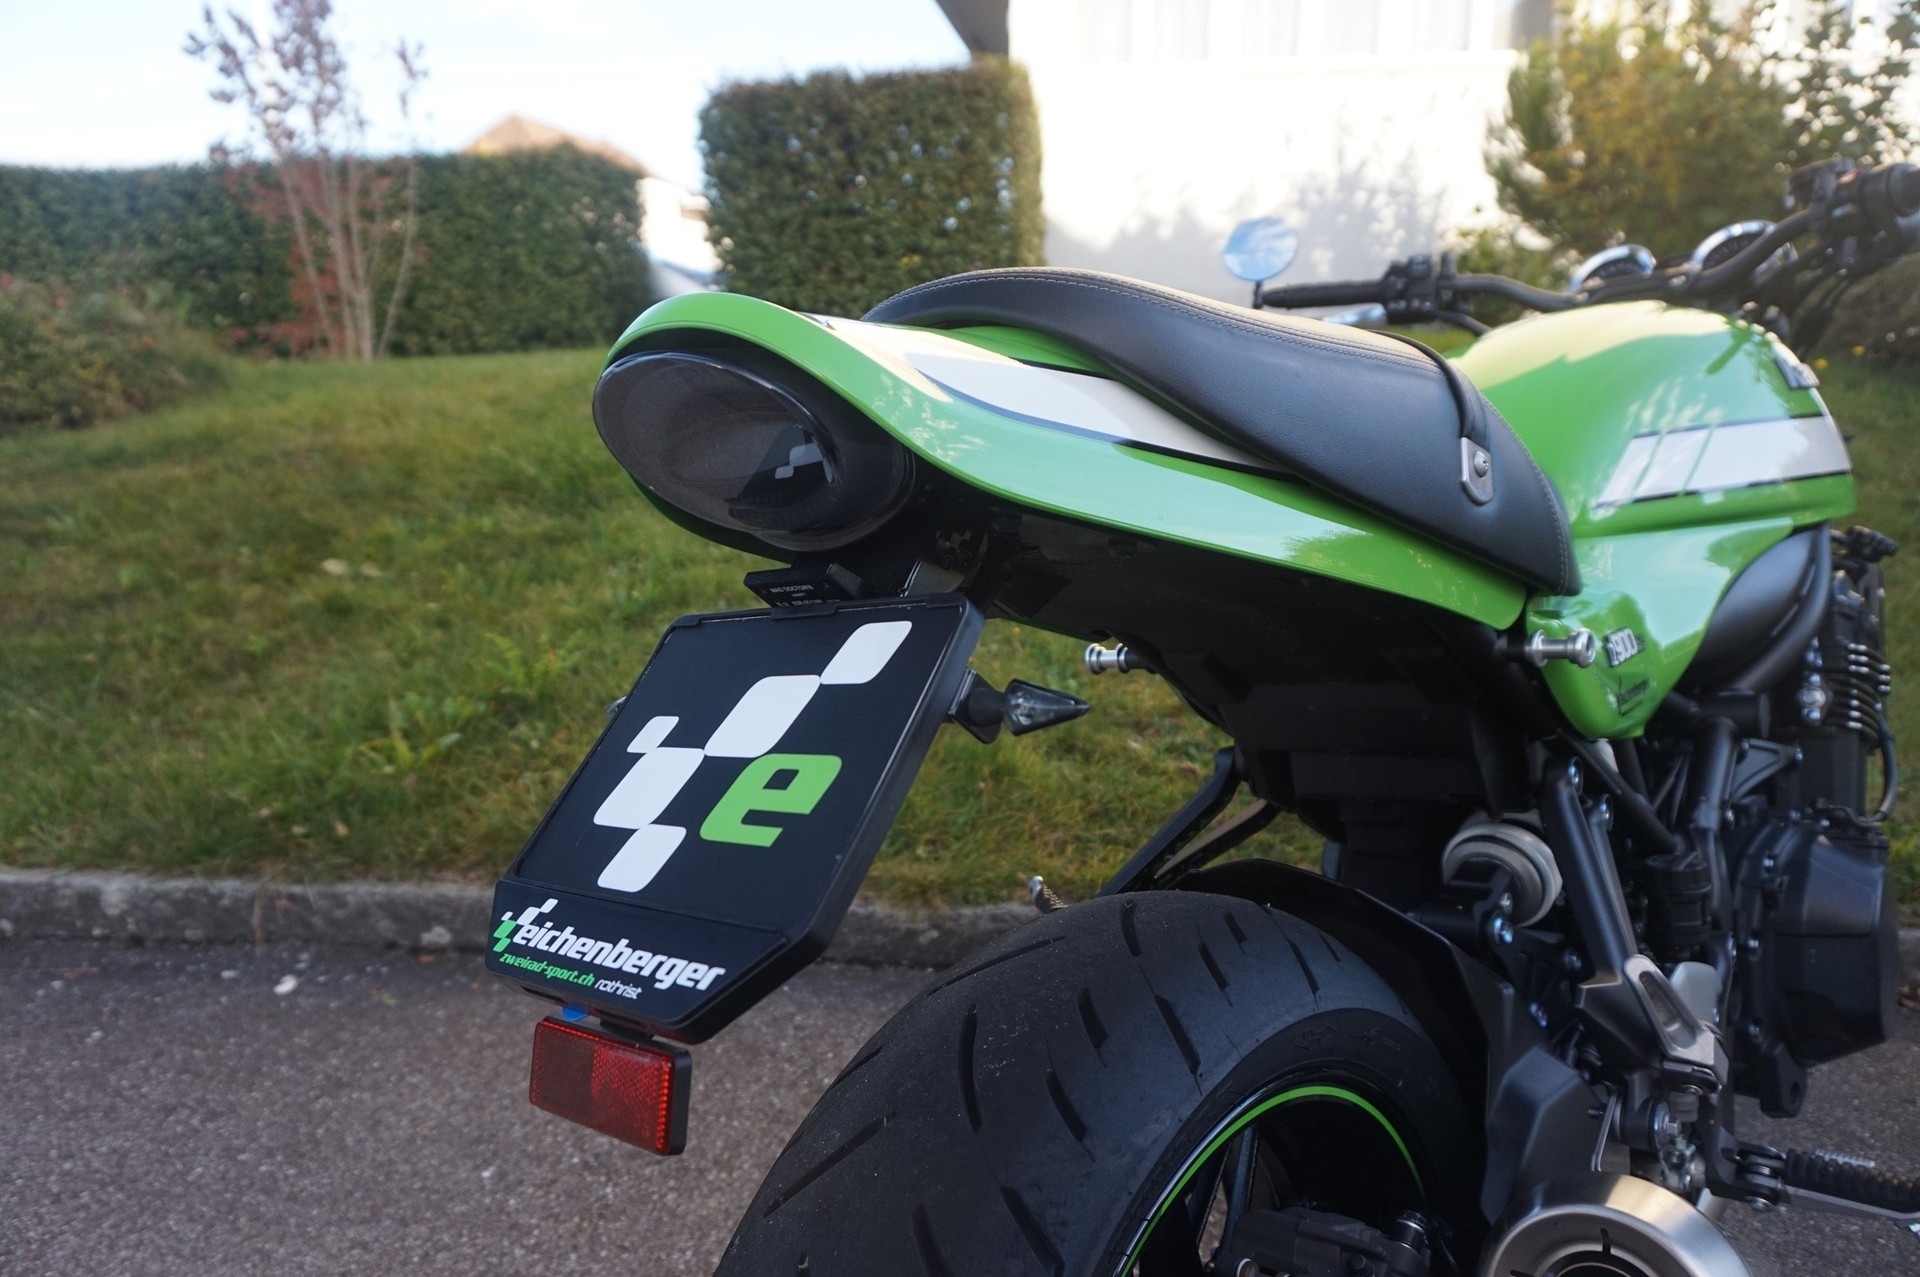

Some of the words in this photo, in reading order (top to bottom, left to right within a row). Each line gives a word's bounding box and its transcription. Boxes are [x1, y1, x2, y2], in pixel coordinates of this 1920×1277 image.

[699, 753, 843, 848] e
[499, 953, 595, 987] zweirad-sport.ch
[594, 978, 643, 1000] rothrist
[512, 921, 727, 991] eichenberger
